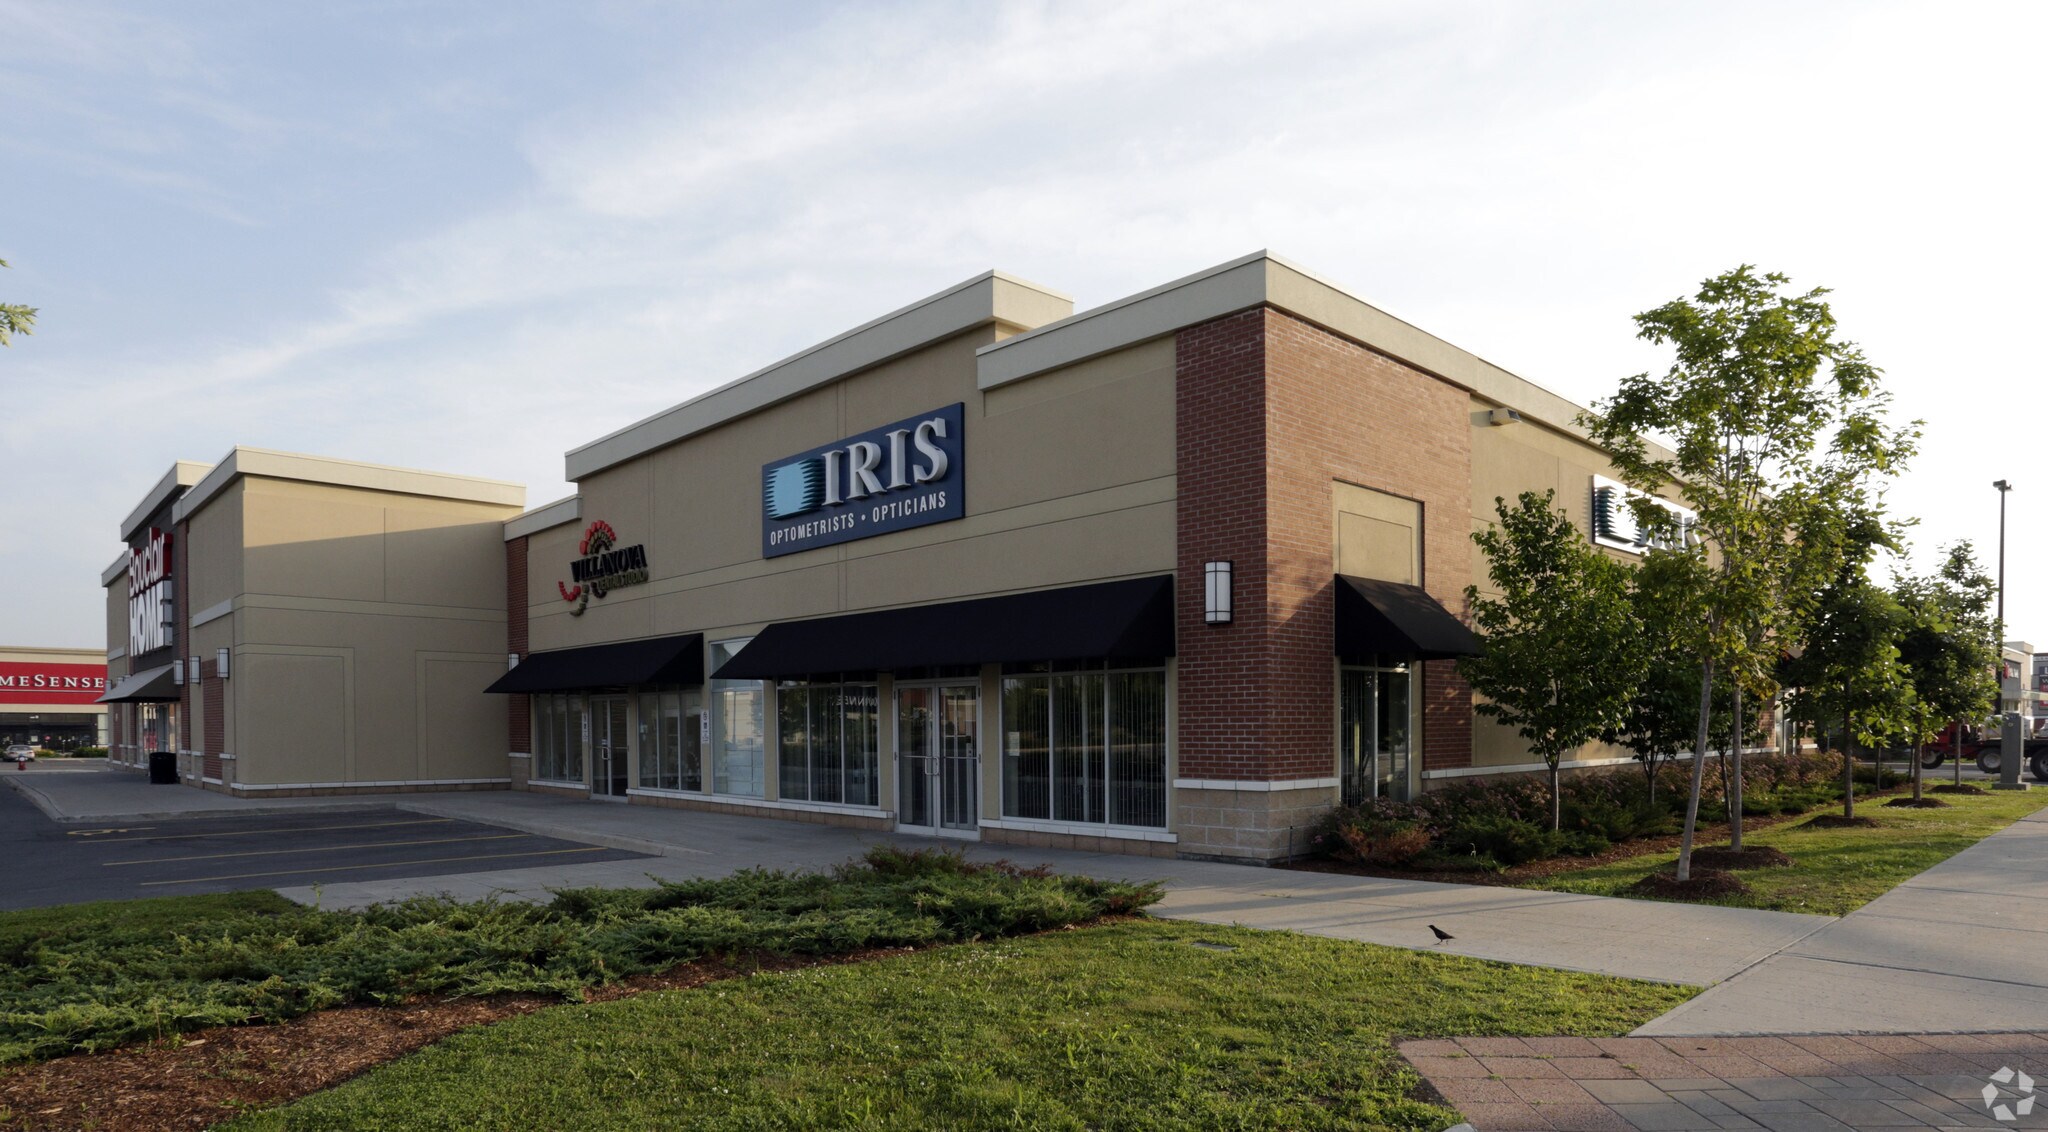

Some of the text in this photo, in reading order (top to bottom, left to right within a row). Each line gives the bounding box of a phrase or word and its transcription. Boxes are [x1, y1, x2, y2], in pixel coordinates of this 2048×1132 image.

[821, 417, 948, 508] IRIS
[770, 491, 946, 546] OPTOMETRISTS OPTICIANS
[129, 527, 167, 598] Bouclair
[570, 544, 648, 583] VILLANOVA
[620, 569, 649, 587] STUDIO
[129, 580, 166, 657] HOME
